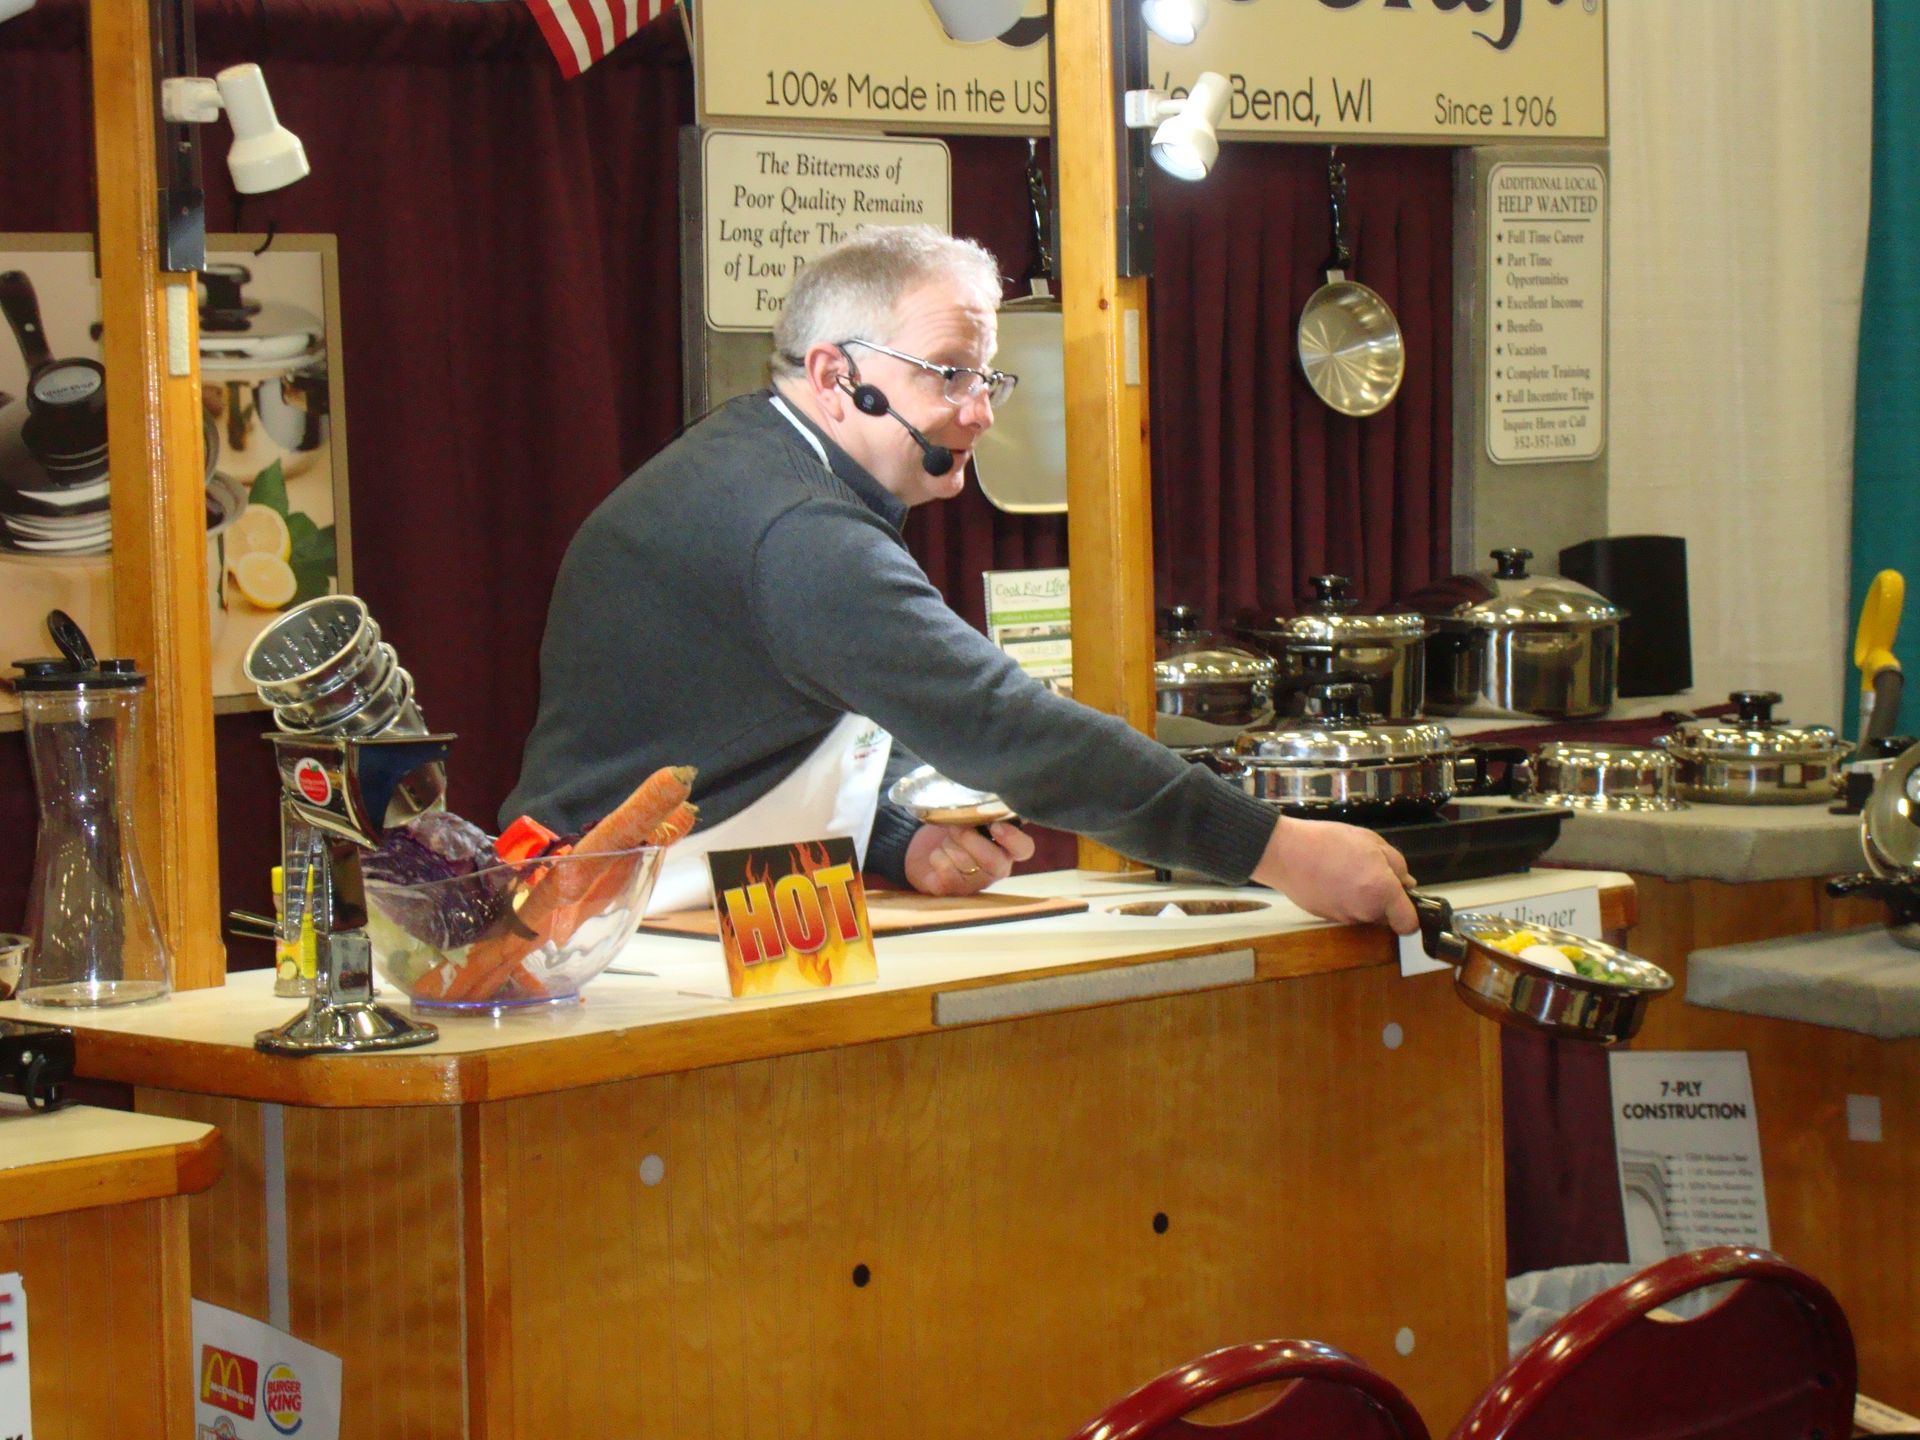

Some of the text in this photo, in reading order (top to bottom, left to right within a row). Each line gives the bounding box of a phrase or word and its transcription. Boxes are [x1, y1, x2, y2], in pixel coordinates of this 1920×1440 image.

[765, 70, 1050, 115] 100% Made in the US
[1229, 73, 1321, 128] Bend,
[1332, 76, 1373, 123] WI
[1435, 93, 1557, 127] Since 1906
[757, 152, 902, 184] The Bitterness of
[1499, 176, 1598, 191] ADDITIONAL LOCAL
[734, 185, 923, 216] Poor Quality Remains
[1497, 195, 1598, 213] HELP WANTED
[719, 219, 763, 247] Long
[770, 221, 810, 248] after
[1507, 230, 1584, 244] Full Time Career
[724, 253, 742, 281] of
[748, 255, 786, 277] Low
[1507, 253, 1552, 267] Part Time
[1506, 272, 1568, 288] Opportunities
[1507, 343, 1547, 356] Vacation
[1507, 389, 1524, 403] Full
[724, 863, 861, 966] HOT
[1660, 1081, 1702, 1096] 7-PLY
[1622, 1103, 1747, 1120] CONSTRUCTION
[267, 1380, 302, 1394] BURGER
[267, 1394, 302, 1413] KING
